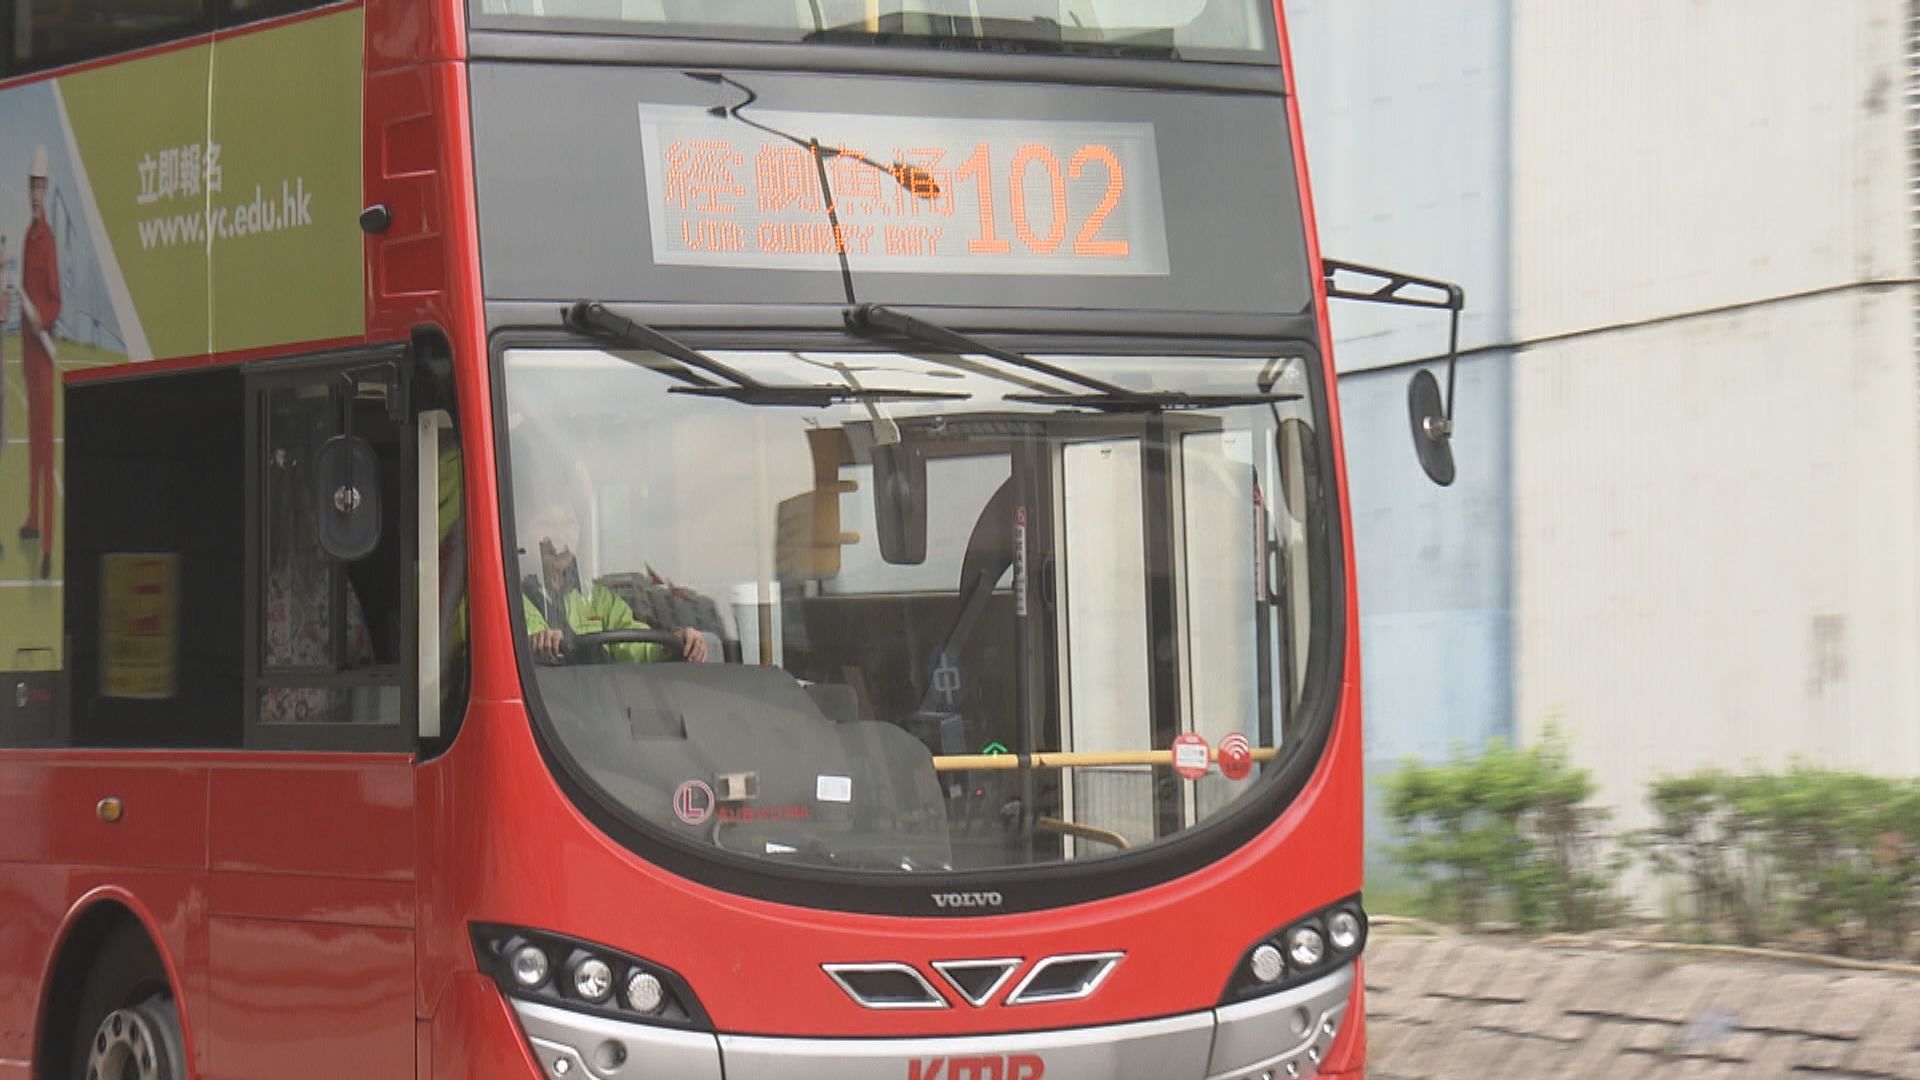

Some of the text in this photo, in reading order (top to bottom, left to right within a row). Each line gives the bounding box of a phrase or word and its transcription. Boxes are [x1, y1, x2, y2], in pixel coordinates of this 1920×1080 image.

[137, 140, 222, 204] 立即報名
[955, 142, 1130, 256] 102
[138, 176, 312, 249] www.yc.edu.hk
[757, 221, 874, 254] QUARRY
[885, 223, 942, 256] BAY
[931, 890, 1004, 908] VOLVO
